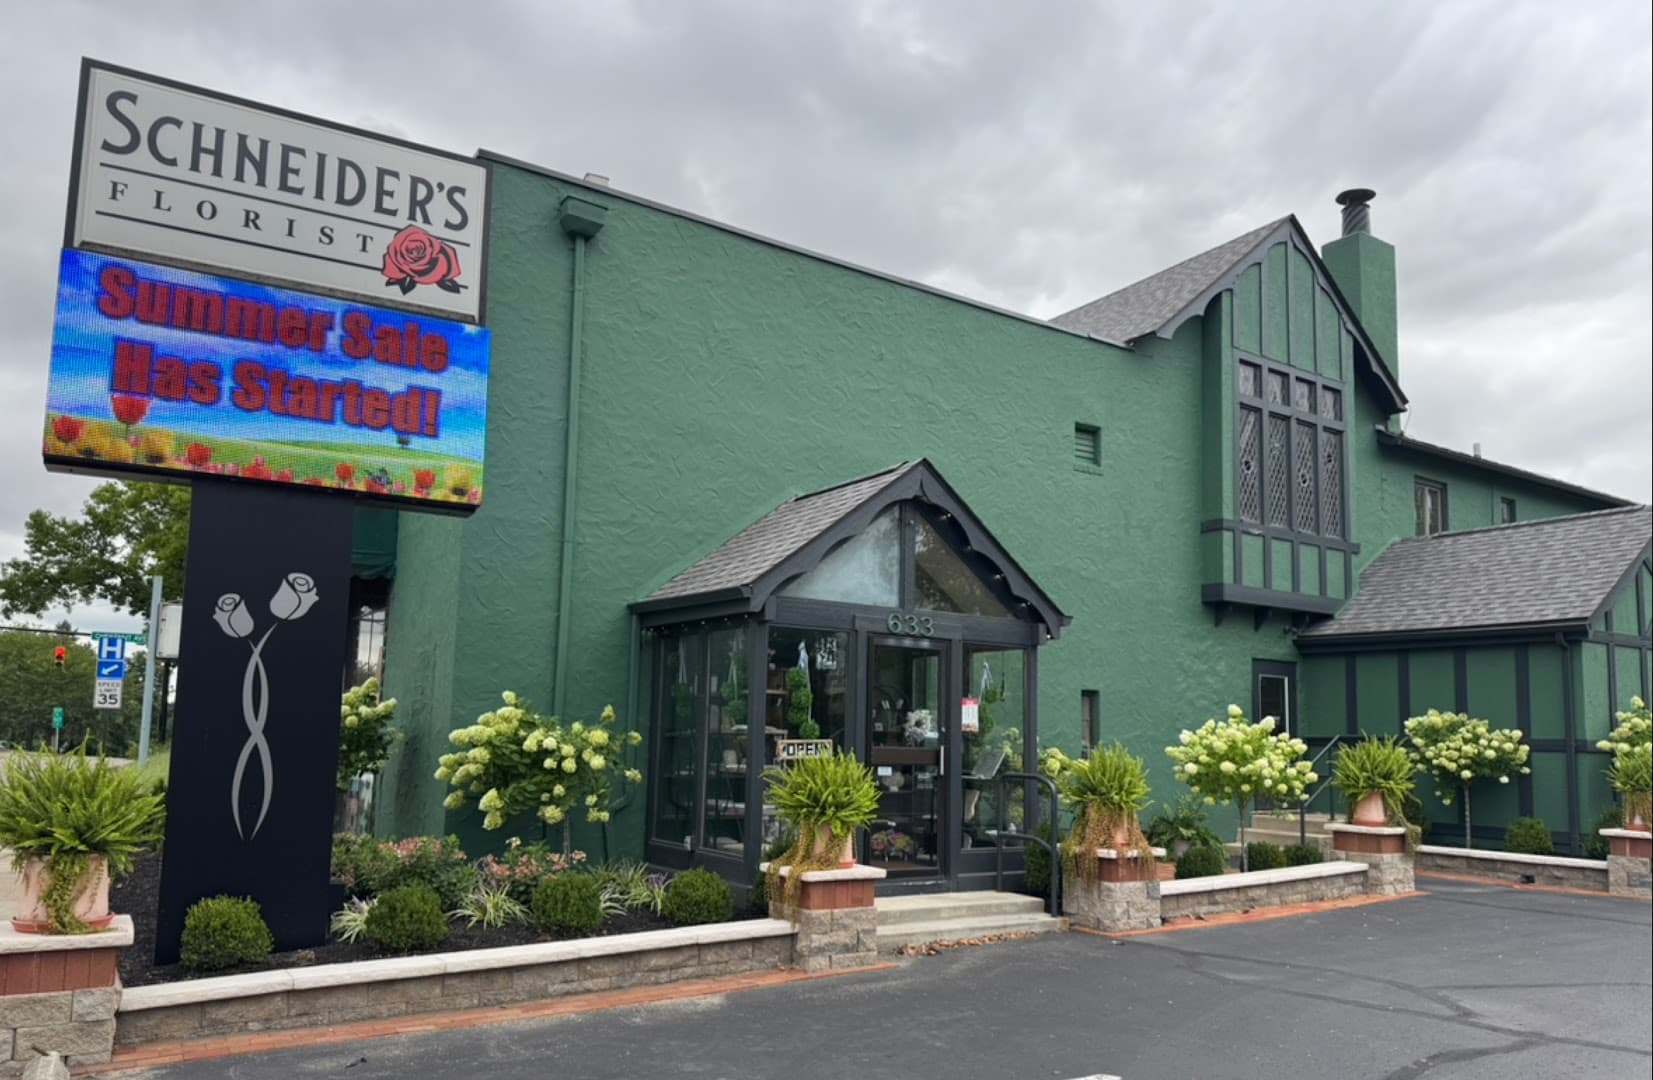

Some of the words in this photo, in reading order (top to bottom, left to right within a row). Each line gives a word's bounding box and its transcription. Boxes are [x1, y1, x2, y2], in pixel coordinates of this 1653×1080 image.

[101, 90, 469, 231] SCHNEIDER'S
[109, 180, 374, 253] FLORIST
[99, 266, 334, 353] Summer
[340, 310, 449, 374] Sale
[111, 337, 222, 405] Has
[231, 360, 442, 438] Started!
[101, 637, 122, 659] H
[888, 613, 935, 637] 633
[98, 694, 119, 705] 35
